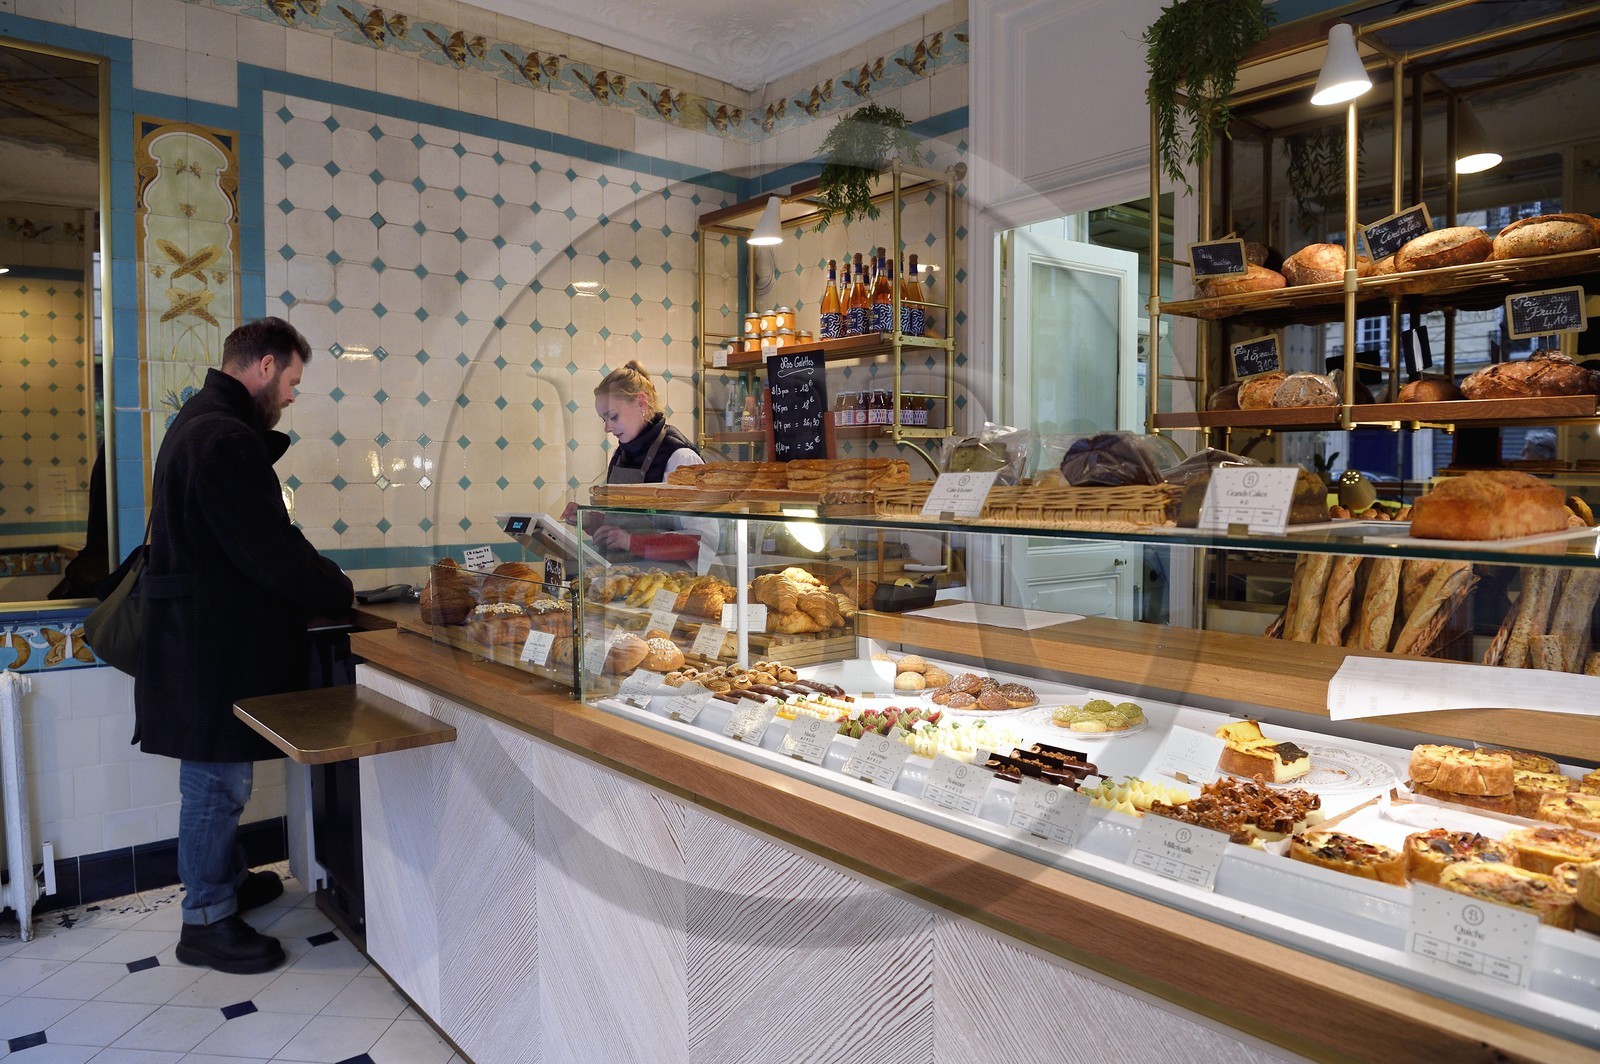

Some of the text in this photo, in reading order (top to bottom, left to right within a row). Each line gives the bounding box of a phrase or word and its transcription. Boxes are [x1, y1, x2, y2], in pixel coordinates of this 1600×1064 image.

[1526, 302, 1568, 320] Fruits
[780, 355, 814, 369] Nos Galettes
[1454, 924, 1486, 940] Quiche
